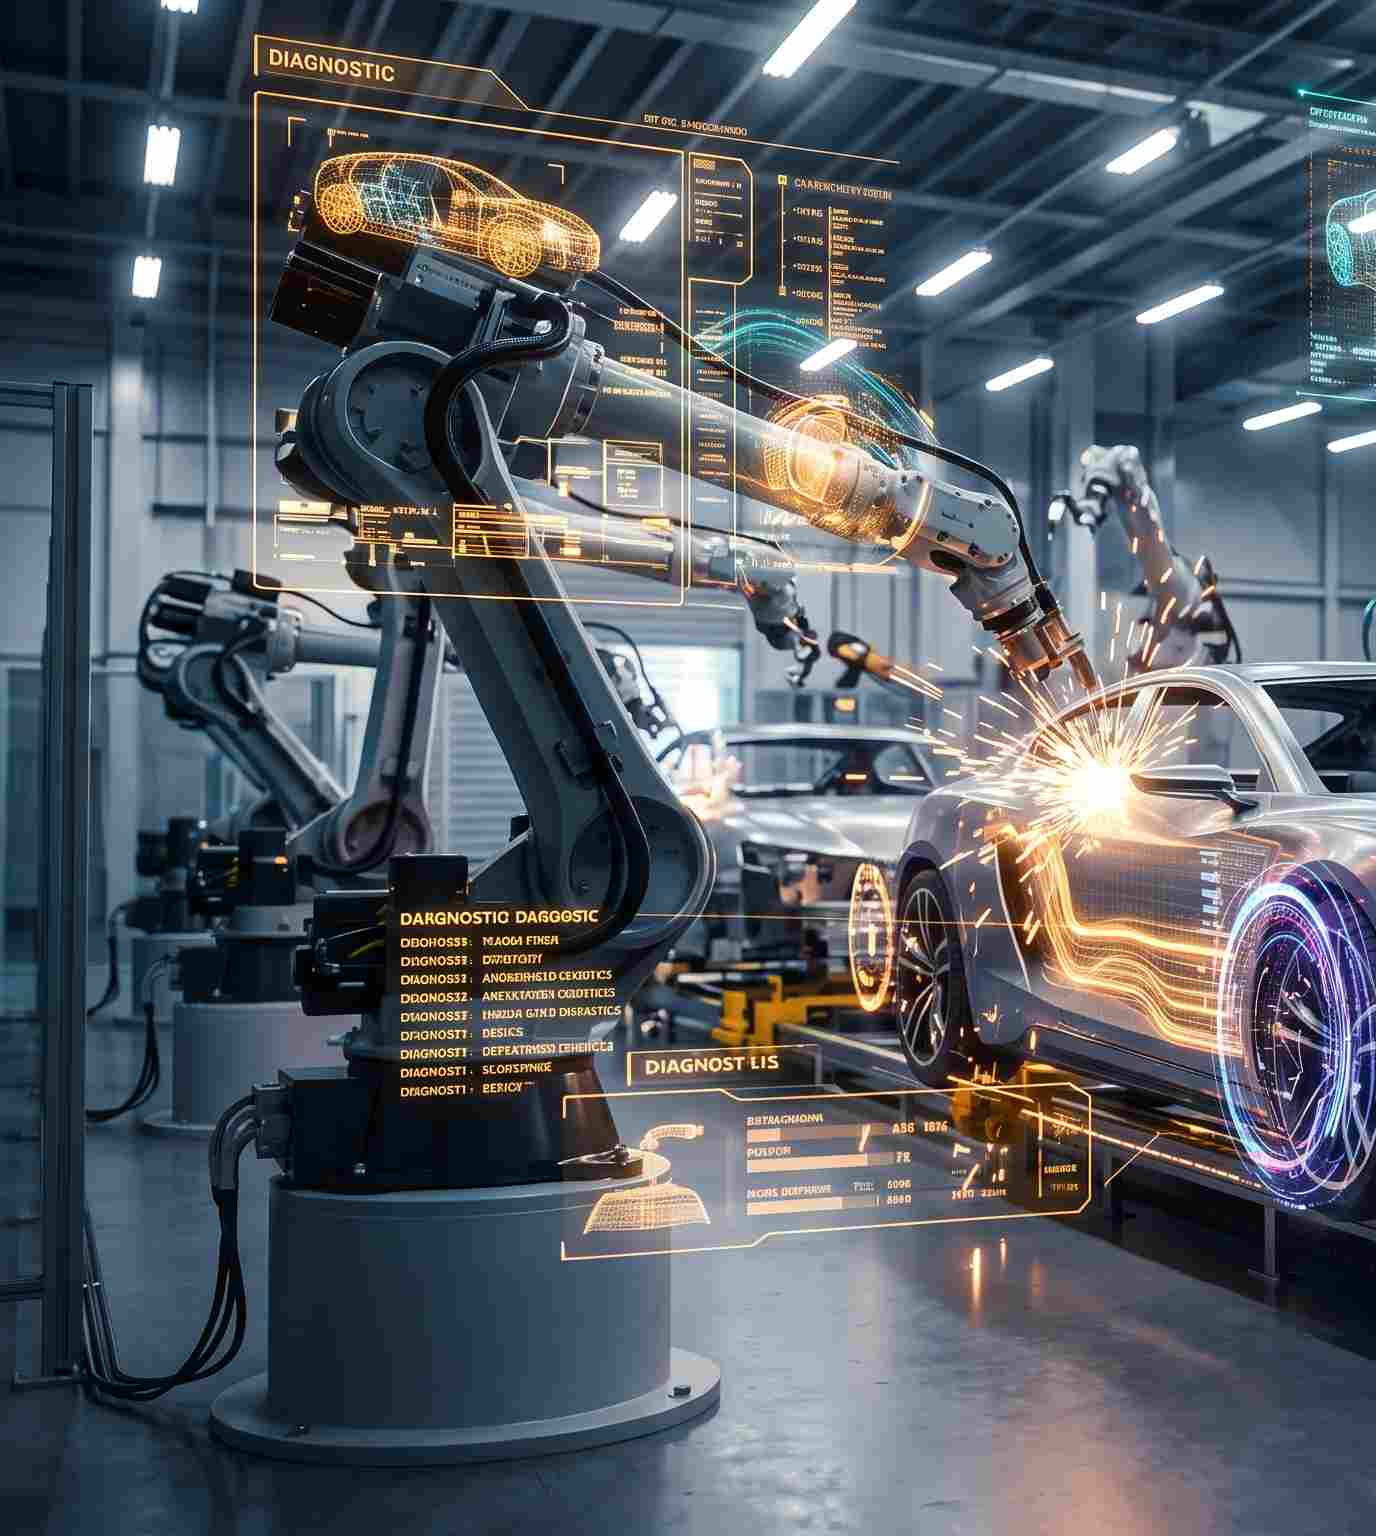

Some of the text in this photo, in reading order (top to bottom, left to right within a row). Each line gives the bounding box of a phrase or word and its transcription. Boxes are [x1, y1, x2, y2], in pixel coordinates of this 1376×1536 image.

[269, 48, 395, 82] DIAGNOSTIC
[646, 1056, 779, 1075] DIAGNOST LIS
